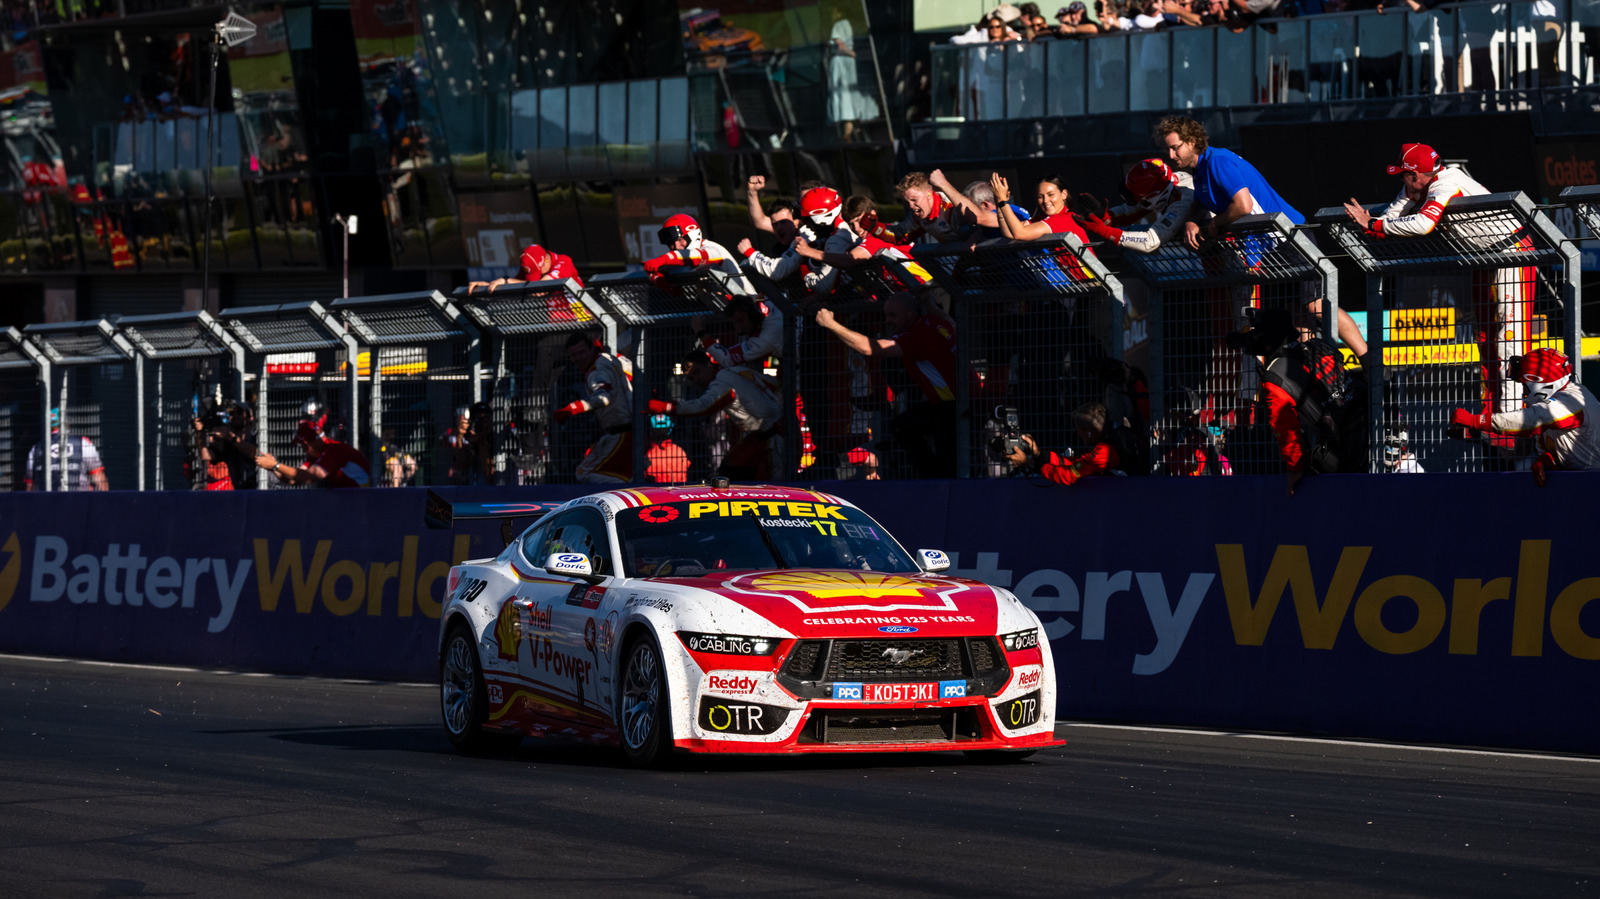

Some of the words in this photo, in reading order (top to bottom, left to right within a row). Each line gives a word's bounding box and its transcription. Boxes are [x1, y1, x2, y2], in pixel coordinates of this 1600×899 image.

[1544, 155, 1598, 187] Coates
[1384, 352, 1420, 363] YRES
[679, 491, 718, 500] Shell
[721, 491, 791, 500] V-Power
[688, 501, 849, 521] PIRTEK
[759, 517, 813, 528] Kostecki
[809, 519, 838, 537] 17
[555, 562, 586, 570] Doric
[30, 535, 254, 634] Battery
[527, 601, 553, 631] Shell
[803, 616, 902, 626] CELEBRATING
[903, 616, 929, 624] 125
[929, 615, 976, 623] YEARS
[883, 625, 914, 634] Ford
[698, 638, 752, 654] CABLING
[529, 633, 591, 685] V-Power
[708, 675, 758, 694] Reddy
[1018, 668, 1041, 686] Reddy
[838, 687, 861, 699] PPQ
[944, 685, 966, 697] PPQ
[708, 704, 764, 731] OTR
[1010, 698, 1037, 726] OTR
